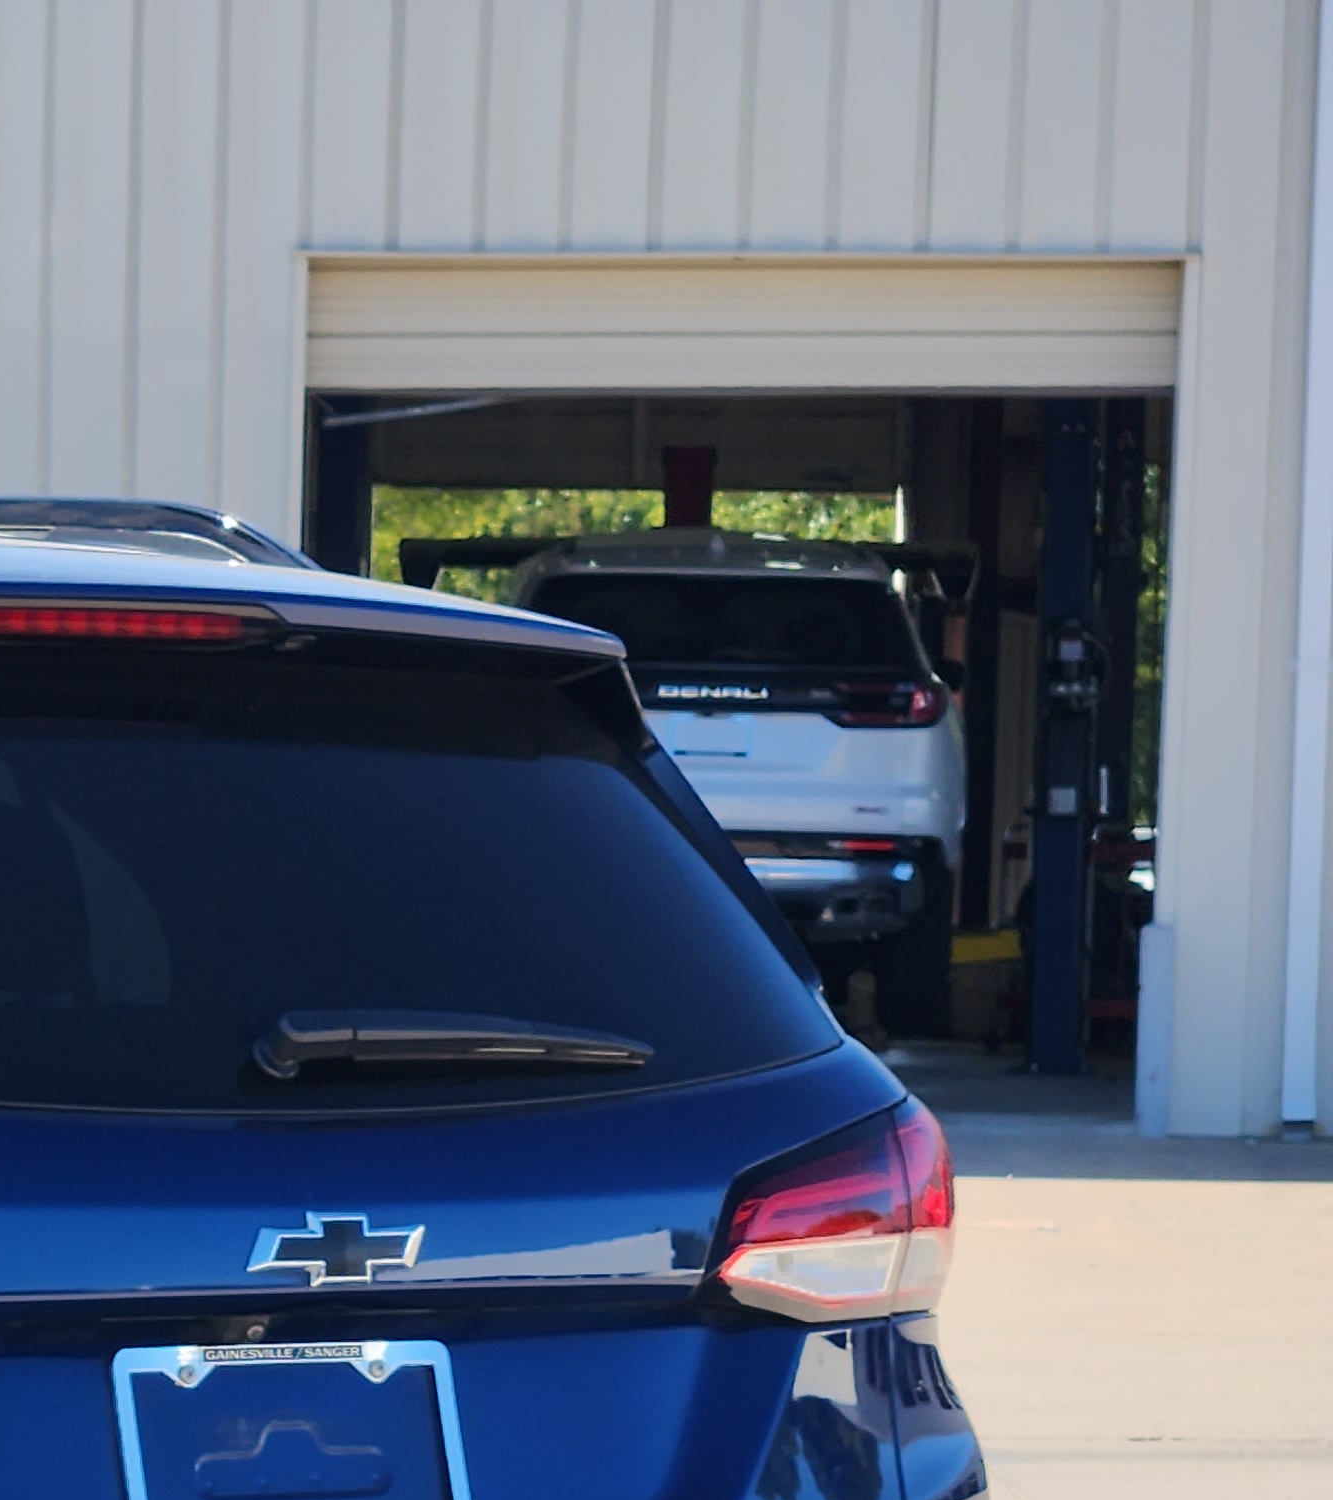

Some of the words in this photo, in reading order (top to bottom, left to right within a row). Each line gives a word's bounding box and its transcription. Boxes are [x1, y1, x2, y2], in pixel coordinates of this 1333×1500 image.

[658, 684, 769, 700] DENALI
[205, 1348, 294, 1361] GAINESVILLE
[303, 1345, 361, 1358] SANGER
